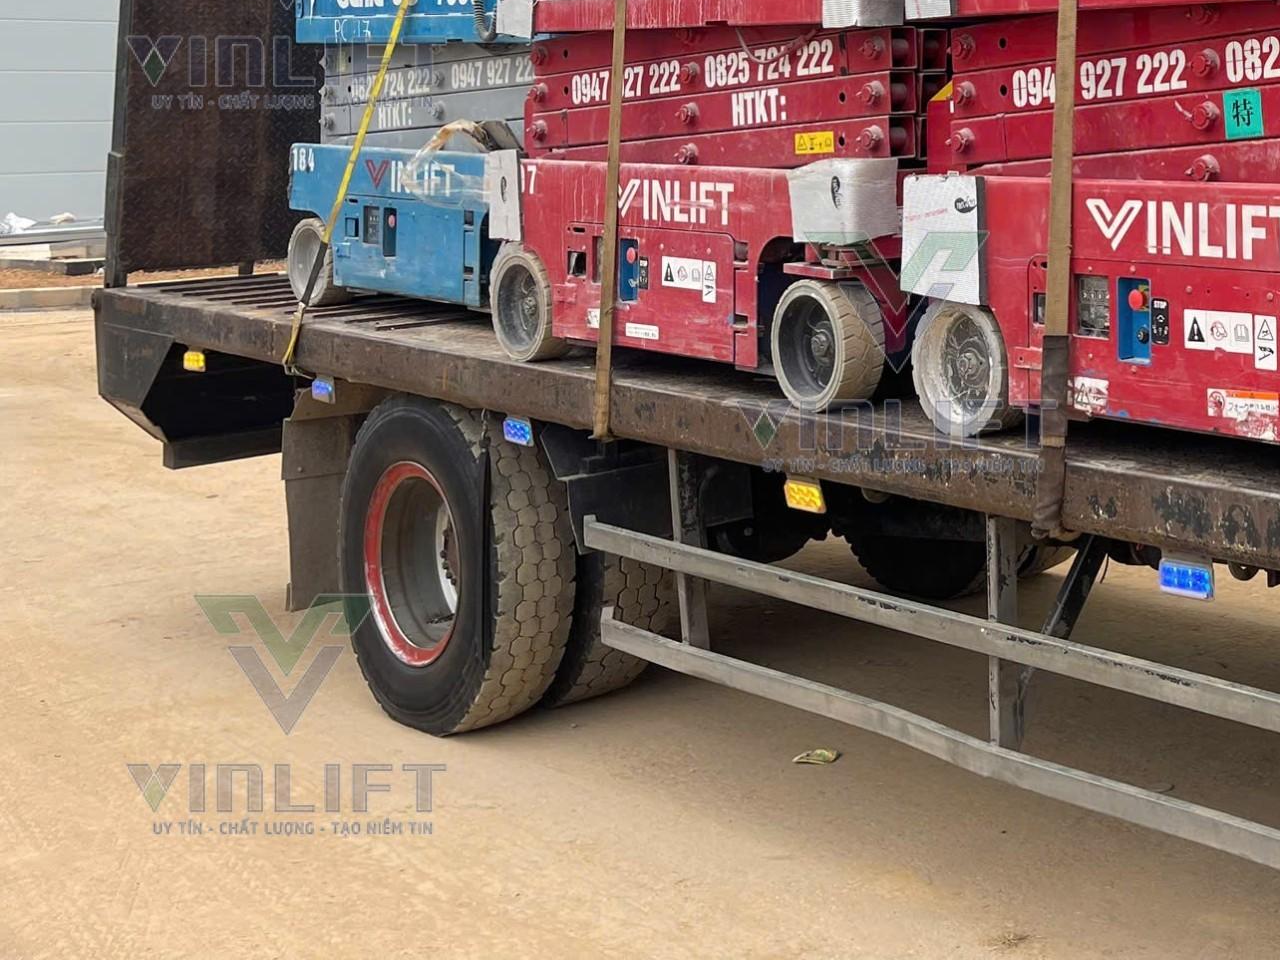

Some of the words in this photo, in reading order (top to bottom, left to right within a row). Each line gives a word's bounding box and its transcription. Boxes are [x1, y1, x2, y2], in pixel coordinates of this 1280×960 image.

[451, 61, 482, 89] 0947
[487, 58, 511, 86] 927
[515, 56, 536, 83] 22
[571, 70, 609, 105] 0947
[621, 65, 644, 98] 27
[649, 59, 681, 95] 222
[704, 51, 750, 88] 0825
[796, 39, 834, 76] 222
[1012, 67, 1056, 109] 094
[1079, 56, 1127, 101] 927
[1136, 49, 1187, 95] 222
[731, 88, 787, 126] HTKT:
[1231, 98, 1254, 128] 特
[292, 148, 315, 172] 184
